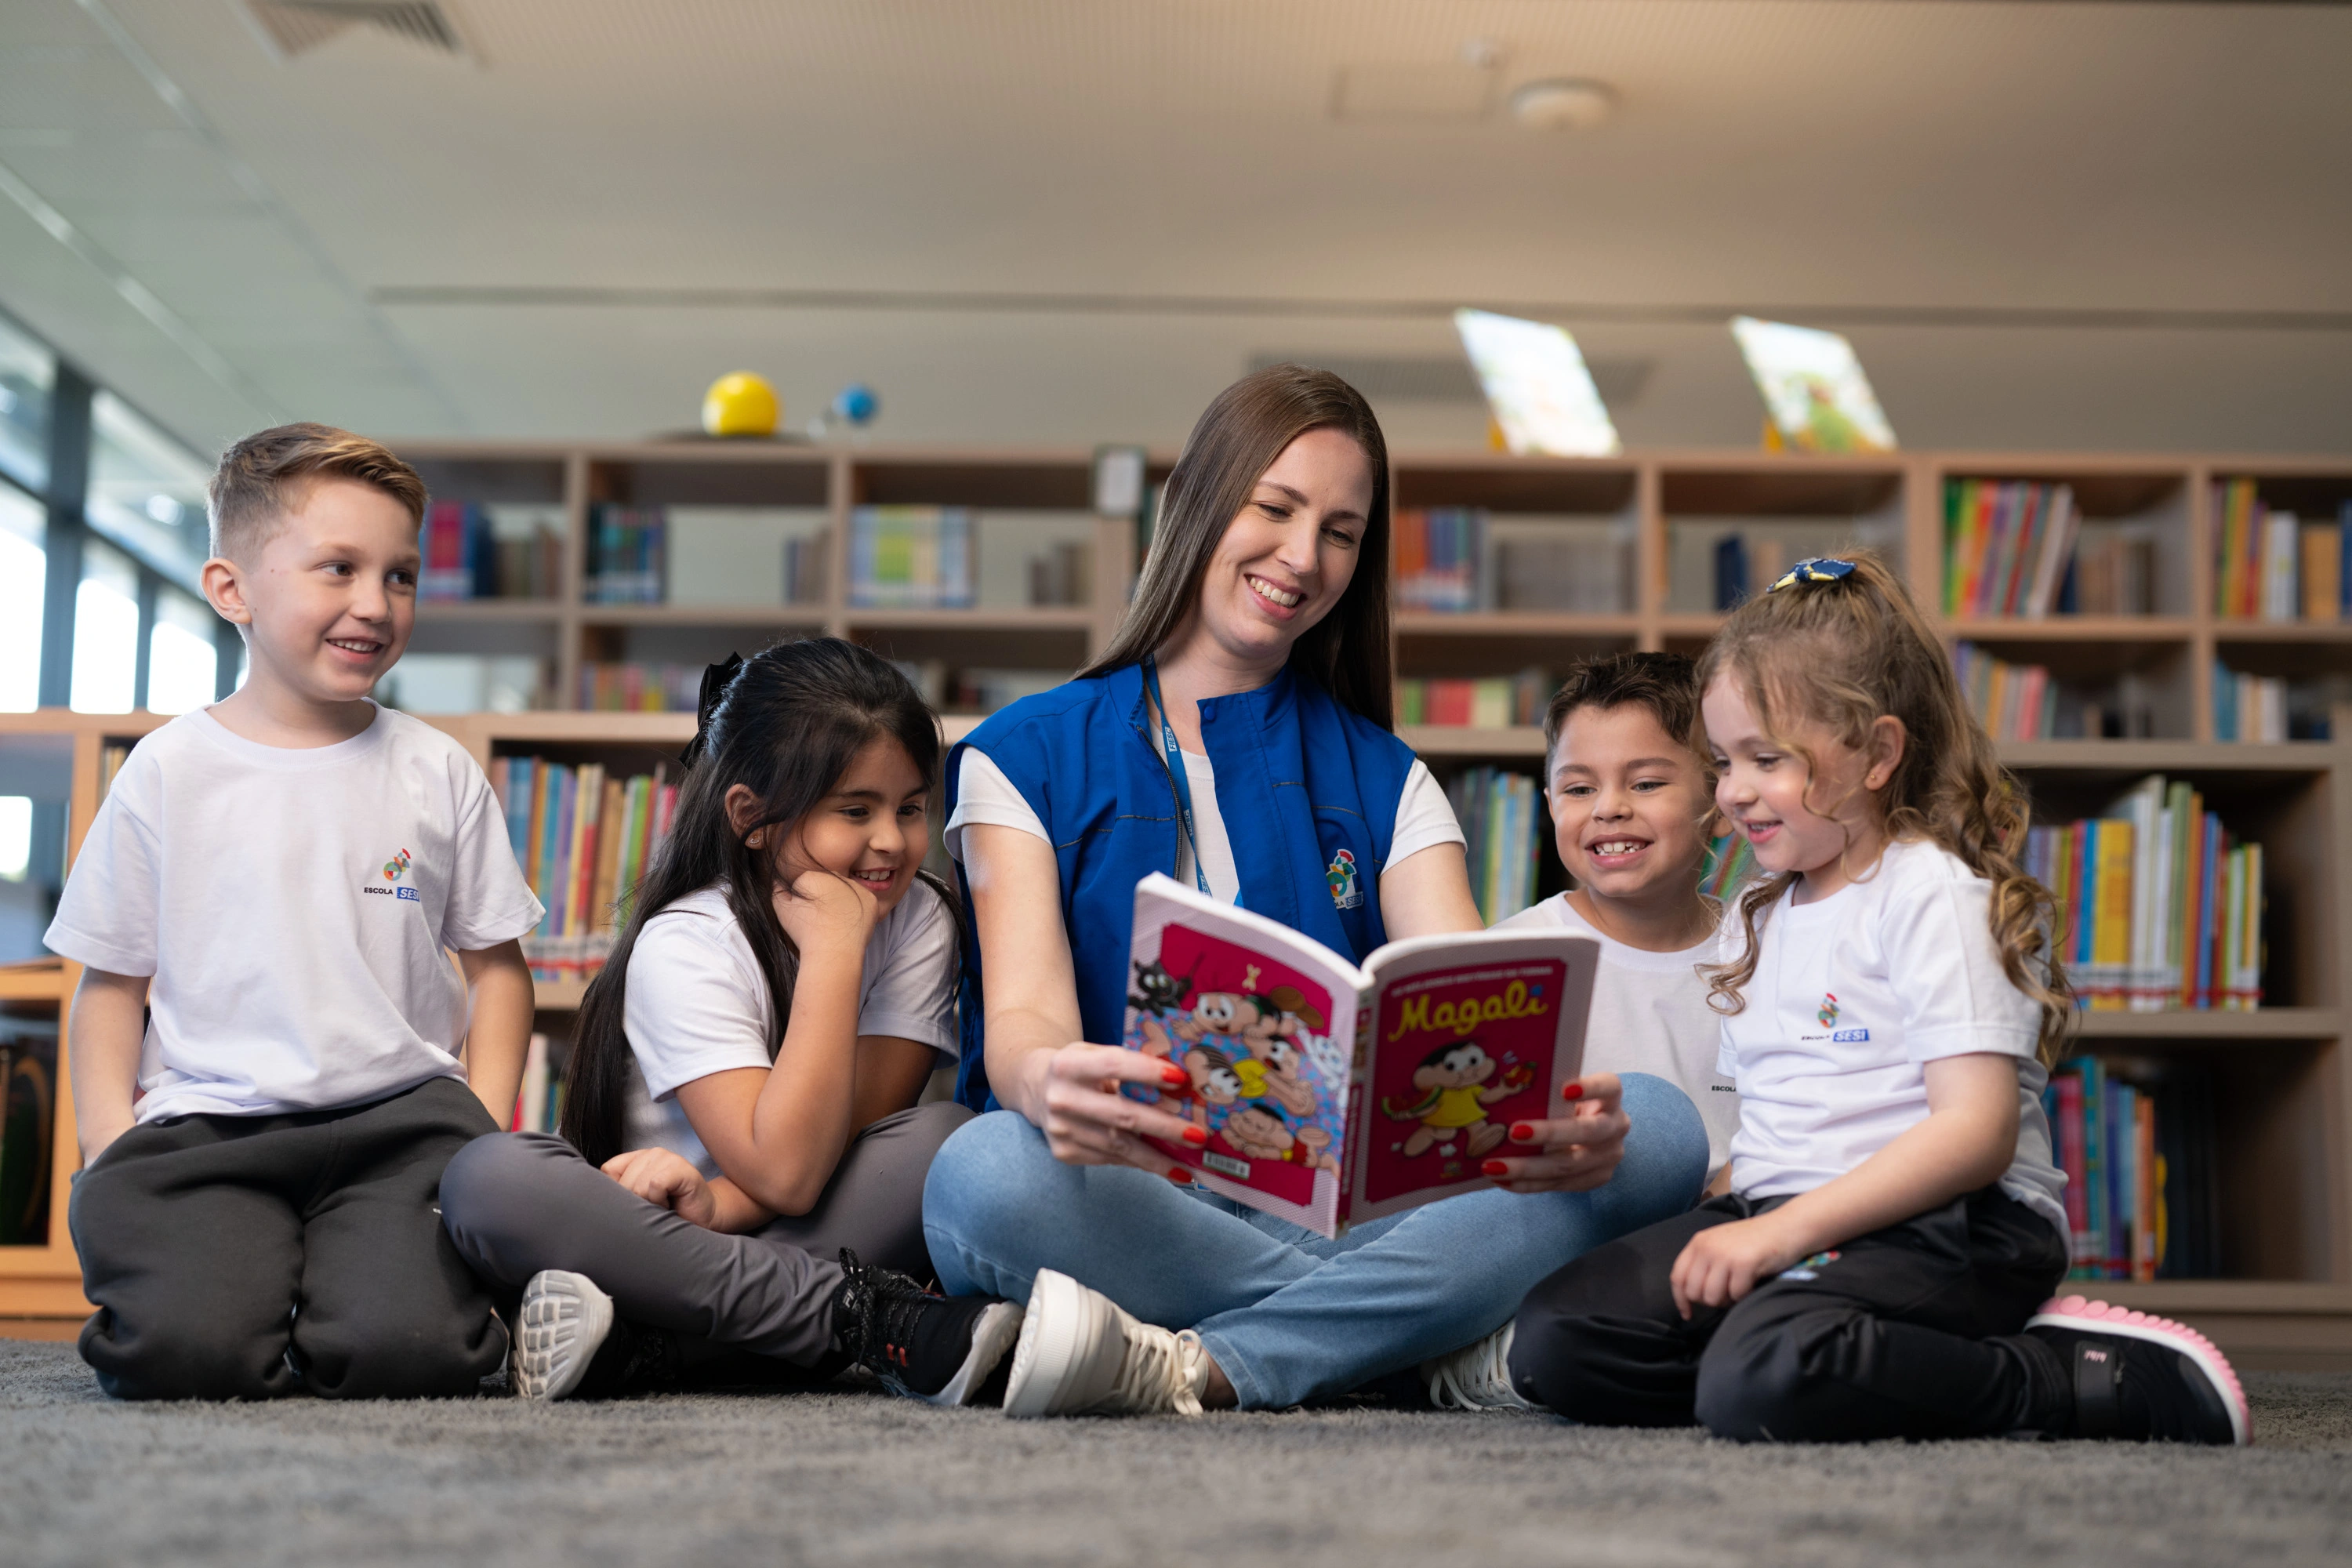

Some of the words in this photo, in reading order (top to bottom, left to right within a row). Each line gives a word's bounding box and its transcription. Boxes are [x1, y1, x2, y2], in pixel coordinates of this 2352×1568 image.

[1166, 726, 1177, 750] FIESC
[398, 888, 419, 900] SESI
[1388, 980, 1549, 1043] Magali
[1834, 1029, 1867, 1041] SESI
